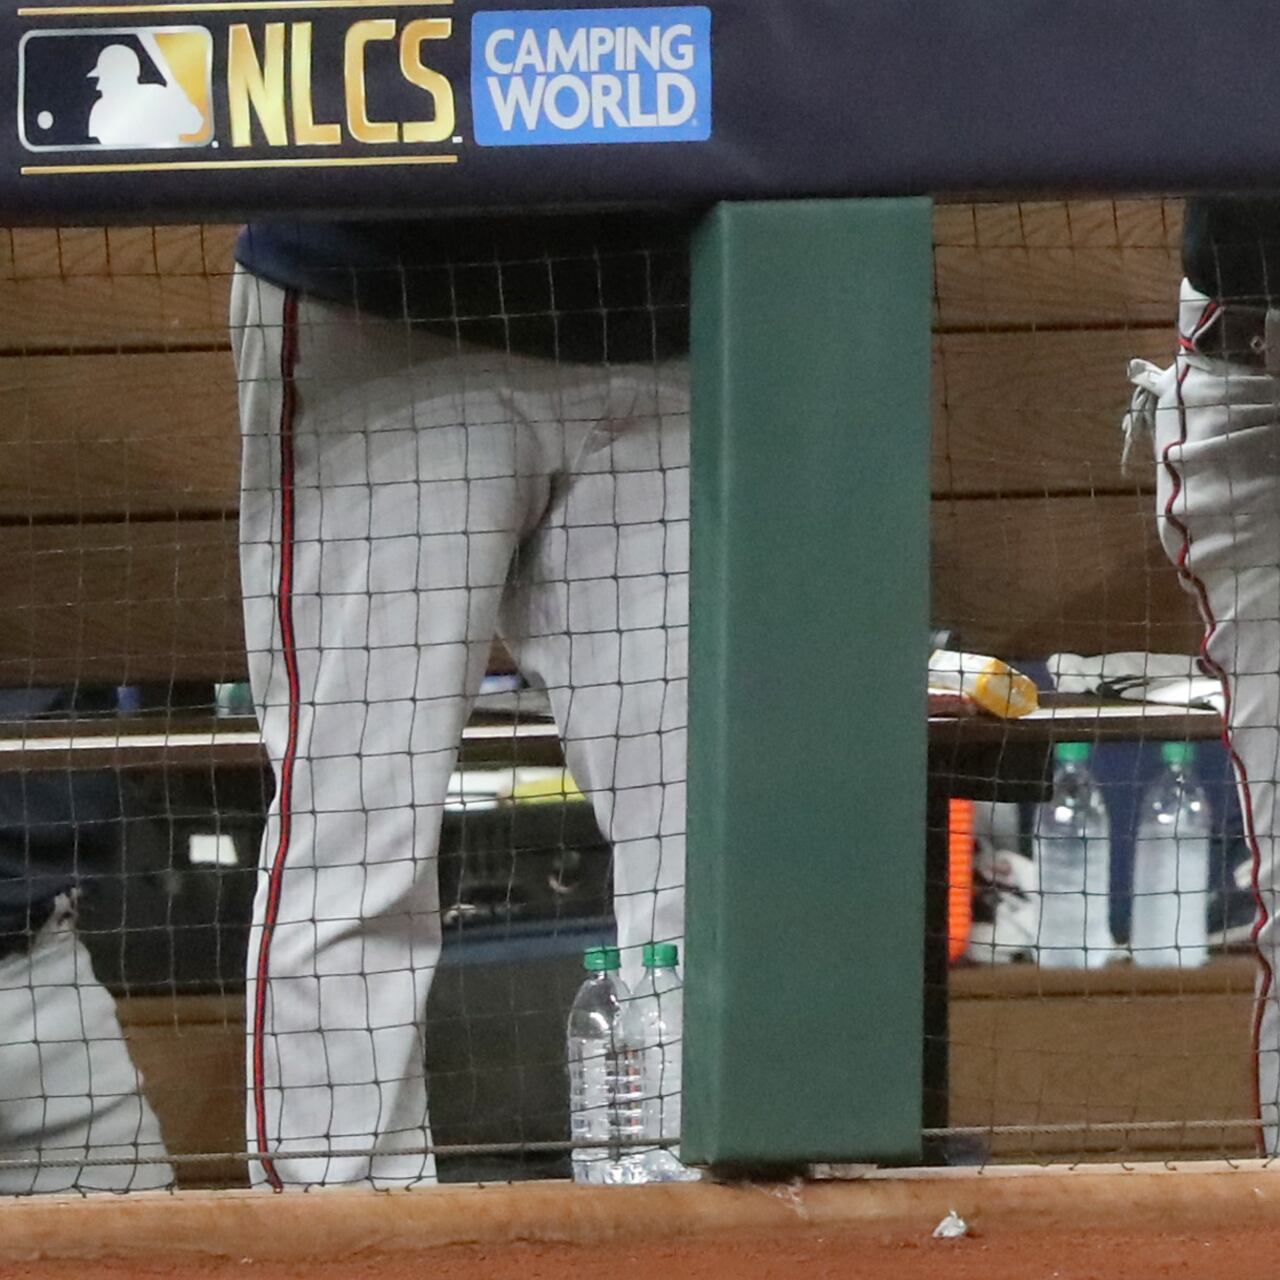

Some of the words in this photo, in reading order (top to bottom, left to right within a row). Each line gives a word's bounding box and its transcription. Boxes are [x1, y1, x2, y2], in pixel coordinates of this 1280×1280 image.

[484, 23, 695, 75] CAMPING
[228, 17, 456, 148] NLCS
[486, 71, 697, 132] WORLD
